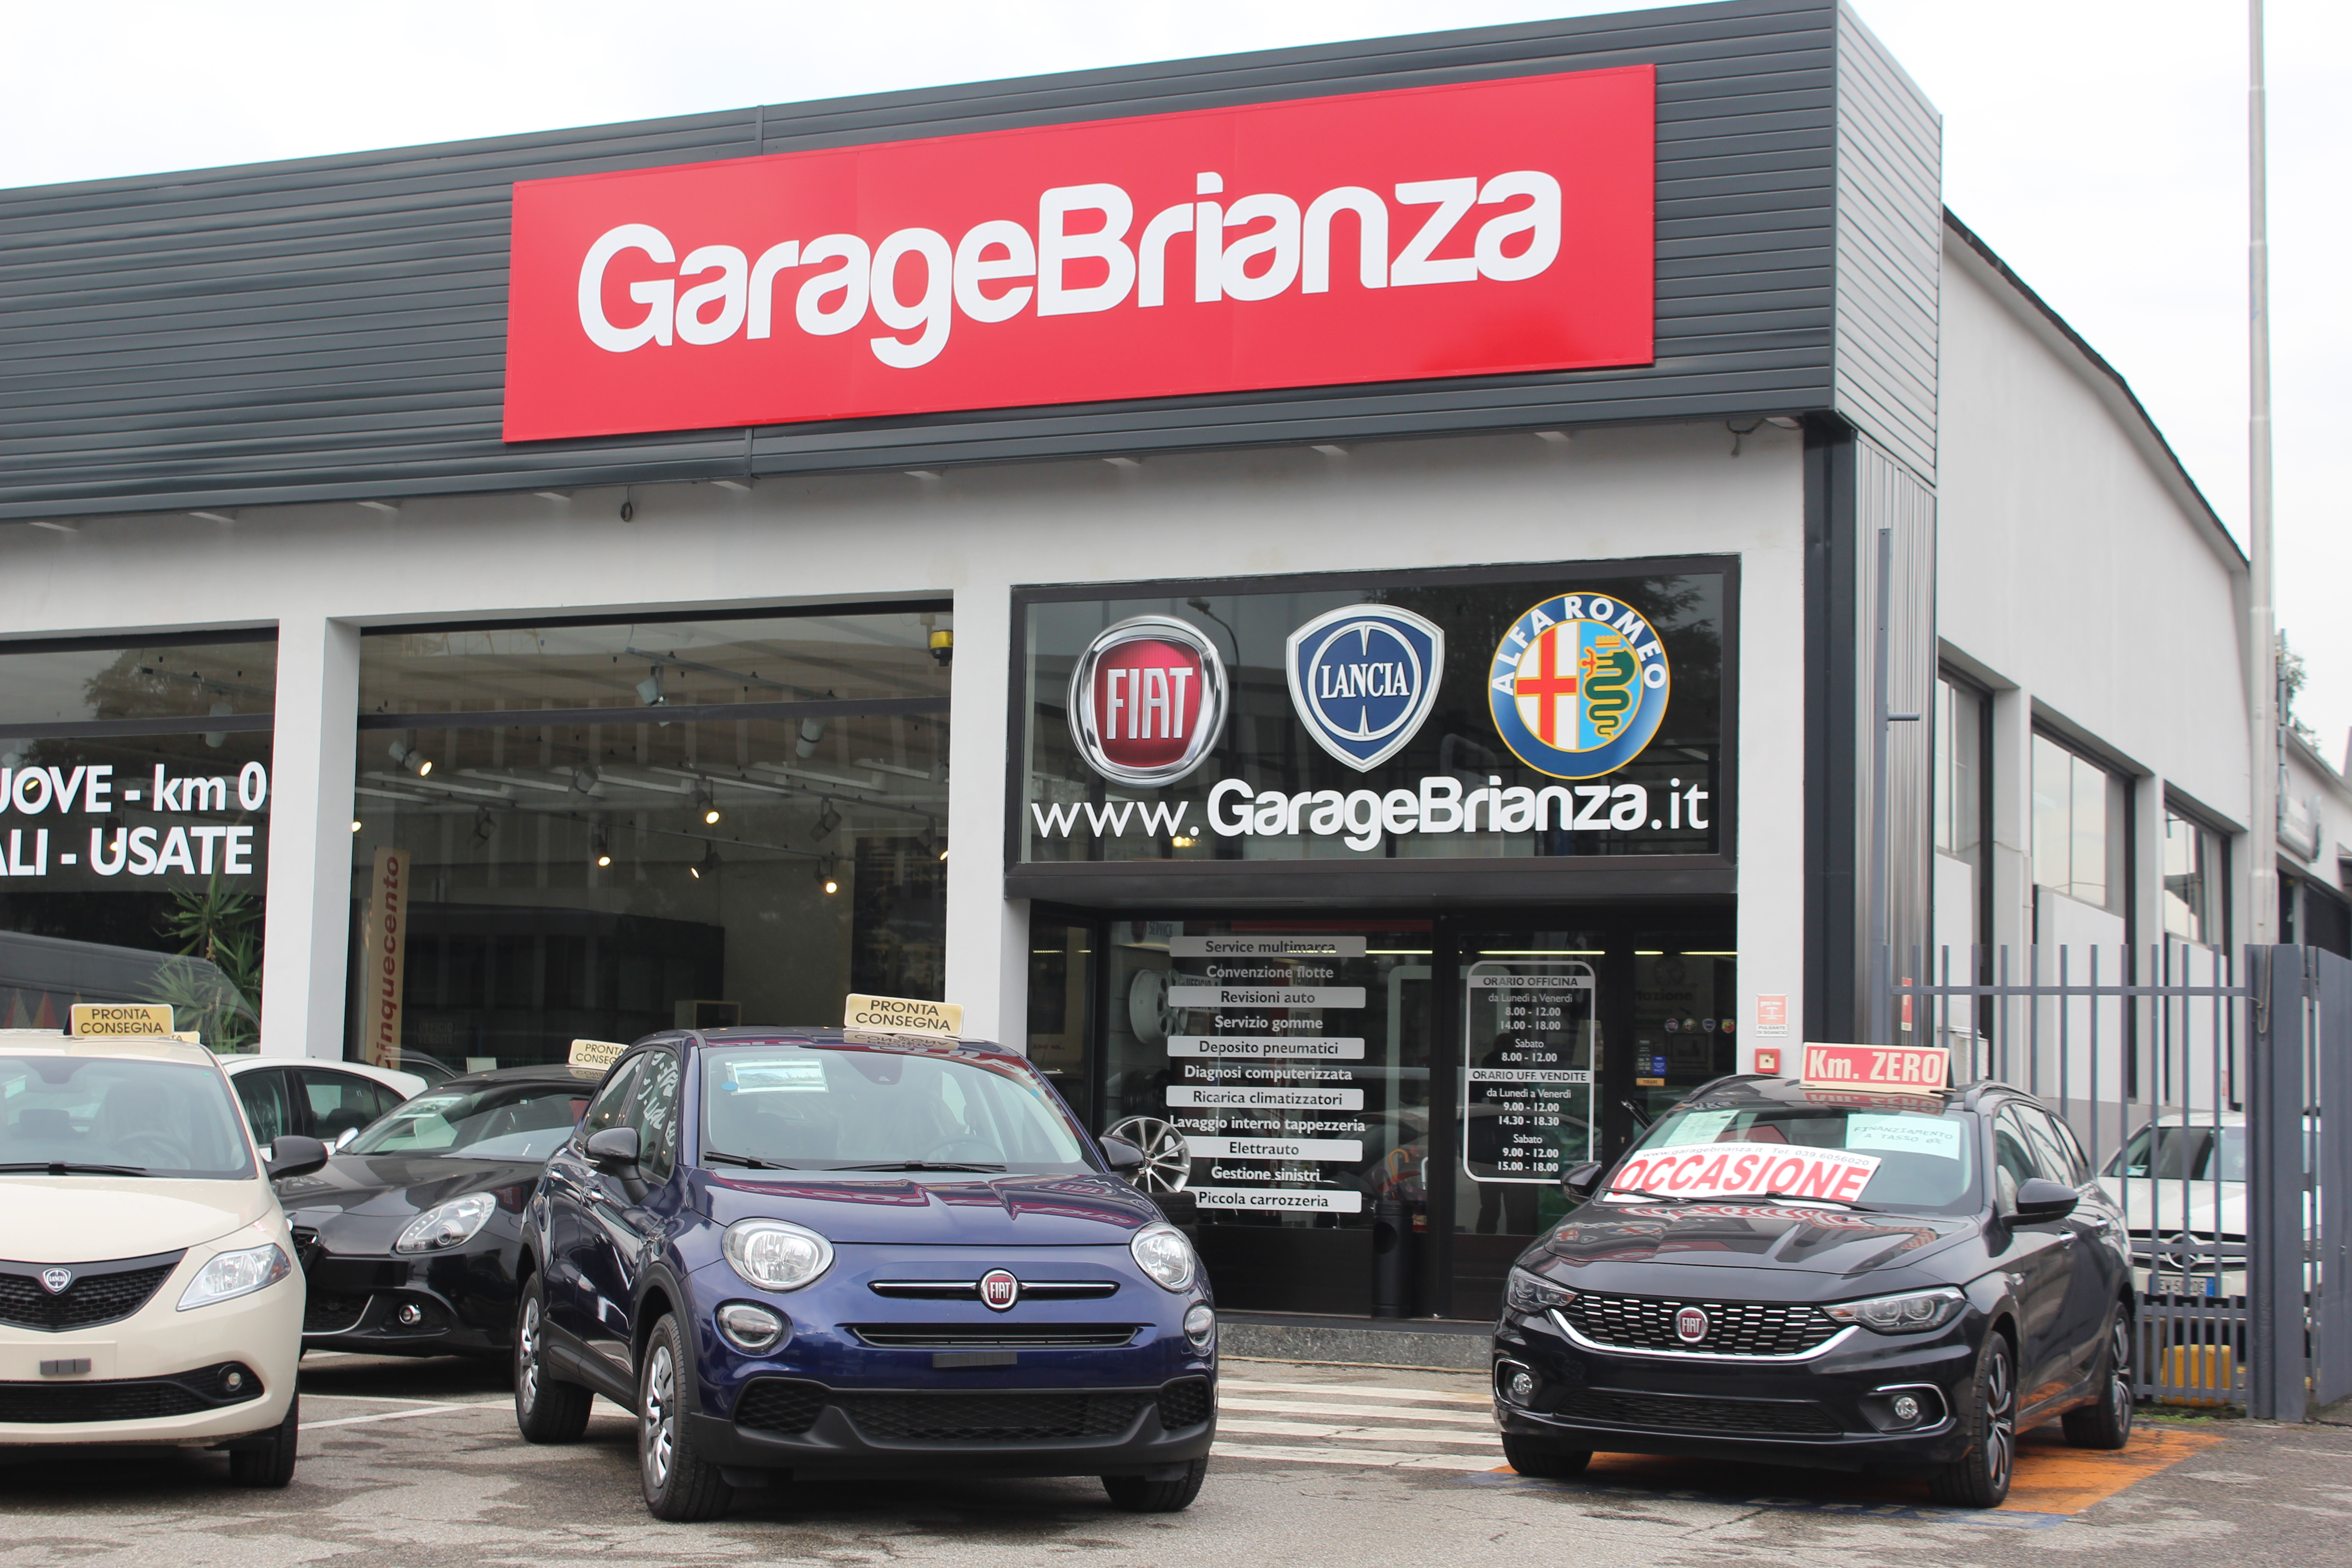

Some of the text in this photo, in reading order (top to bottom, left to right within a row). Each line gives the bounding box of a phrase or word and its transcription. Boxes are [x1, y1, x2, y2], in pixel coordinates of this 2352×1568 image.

[578, 171, 1562, 368] GarageBrianza
[1492, 595, 1667, 696] ALFA ROMEO
[1320, 662, 1410, 699] LANCIA
[1106, 667, 1193, 740] FIAT
[125, 789, 140, 801] -
[154, 764, 226, 811] km
[239, 761, 267, 811] 0
[0, 826, 253, 876] LI - USATE
[1205, 940, 1335, 953] Service multimarca
[1206, 965, 1334, 979] Convenzione flotte
[1484, 977, 1578, 986] ORARIO OFFICINA
[1221, 990, 1315, 1004] Revisioni auto
[1489, 994, 1499, 1002] da
[92, 1009, 151, 1020] PRONTA
[870, 1000, 939, 1016] PRONTA
[1505, 1007, 1526, 1016] 8.00
[1536, 1008, 1561, 1016] 12.00
[80, 1022, 164, 1034] CONSEGNA
[855, 1012, 951, 1031] CONSEGNA
[1215, 1016, 1323, 1032] Servizio gomme
[1500, 1021, 1526, 1030] 14.00
[1536, 1022, 1561, 1030] 18.00
[585, 1044, 624, 1055] PRONTA
[1200, 1040, 1338, 1057] Deposito pneumatici
[1515, 1039, 1544, 1048] Sabato
[576, 1053, 616, 1065] CONSEG
[1501, 1053, 1522, 1062] 8.00
[1532, 1054, 1558, 1062] 12.00
[1809, 1049, 1942, 1083] Km. ZERO
[1185, 1065, 1352, 1083] Diagnosi computerizzata
[1473, 1071, 1587, 1081] ORARIO UFF. VENDITE
[1193, 1090, 1342, 1106] Ricarica climatizzatori
[1487, 1088, 1497, 1097] da
[1503, 1102, 1524, 1111] 9.00
[1534, 1103, 1559, 1112] 12.00
[1170, 1115, 1366, 1133] Lavaggio interno tappezzeria
[1499, 1116, 1524, 1125] 14.30
[1534, 1117, 1559, 1126] 18.30
[1513, 1134, 1543, 1143] Sabato
[1854, 1126, 1953, 1139] FINANZIAMENTO
[1881, 1134, 1919, 1142] TASSO
[1230, 1142, 1299, 1155] Elettrauto
[1503, 1148, 1523, 1157] 9.00
[1533, 1149, 1559, 1158] 12.00
[1642, 1147, 1764, 1157] www.garagebrianza.it
[1795, 1150, 1869, 1166] 039.6056020
[1211, 1166, 1320, 1181] Gestione sinistri
[1498, 1161, 1523, 1171] 15.00
[1533, 1162, 1559, 1172] 18.00
[1612, 1154, 1870, 1201] OCCASIONE
[1199, 1192, 1328, 1207] Piccola carrozzeria
[990, 1282, 1010, 1298] FIAT
[1682, 1317, 1701, 1333] FIAT
